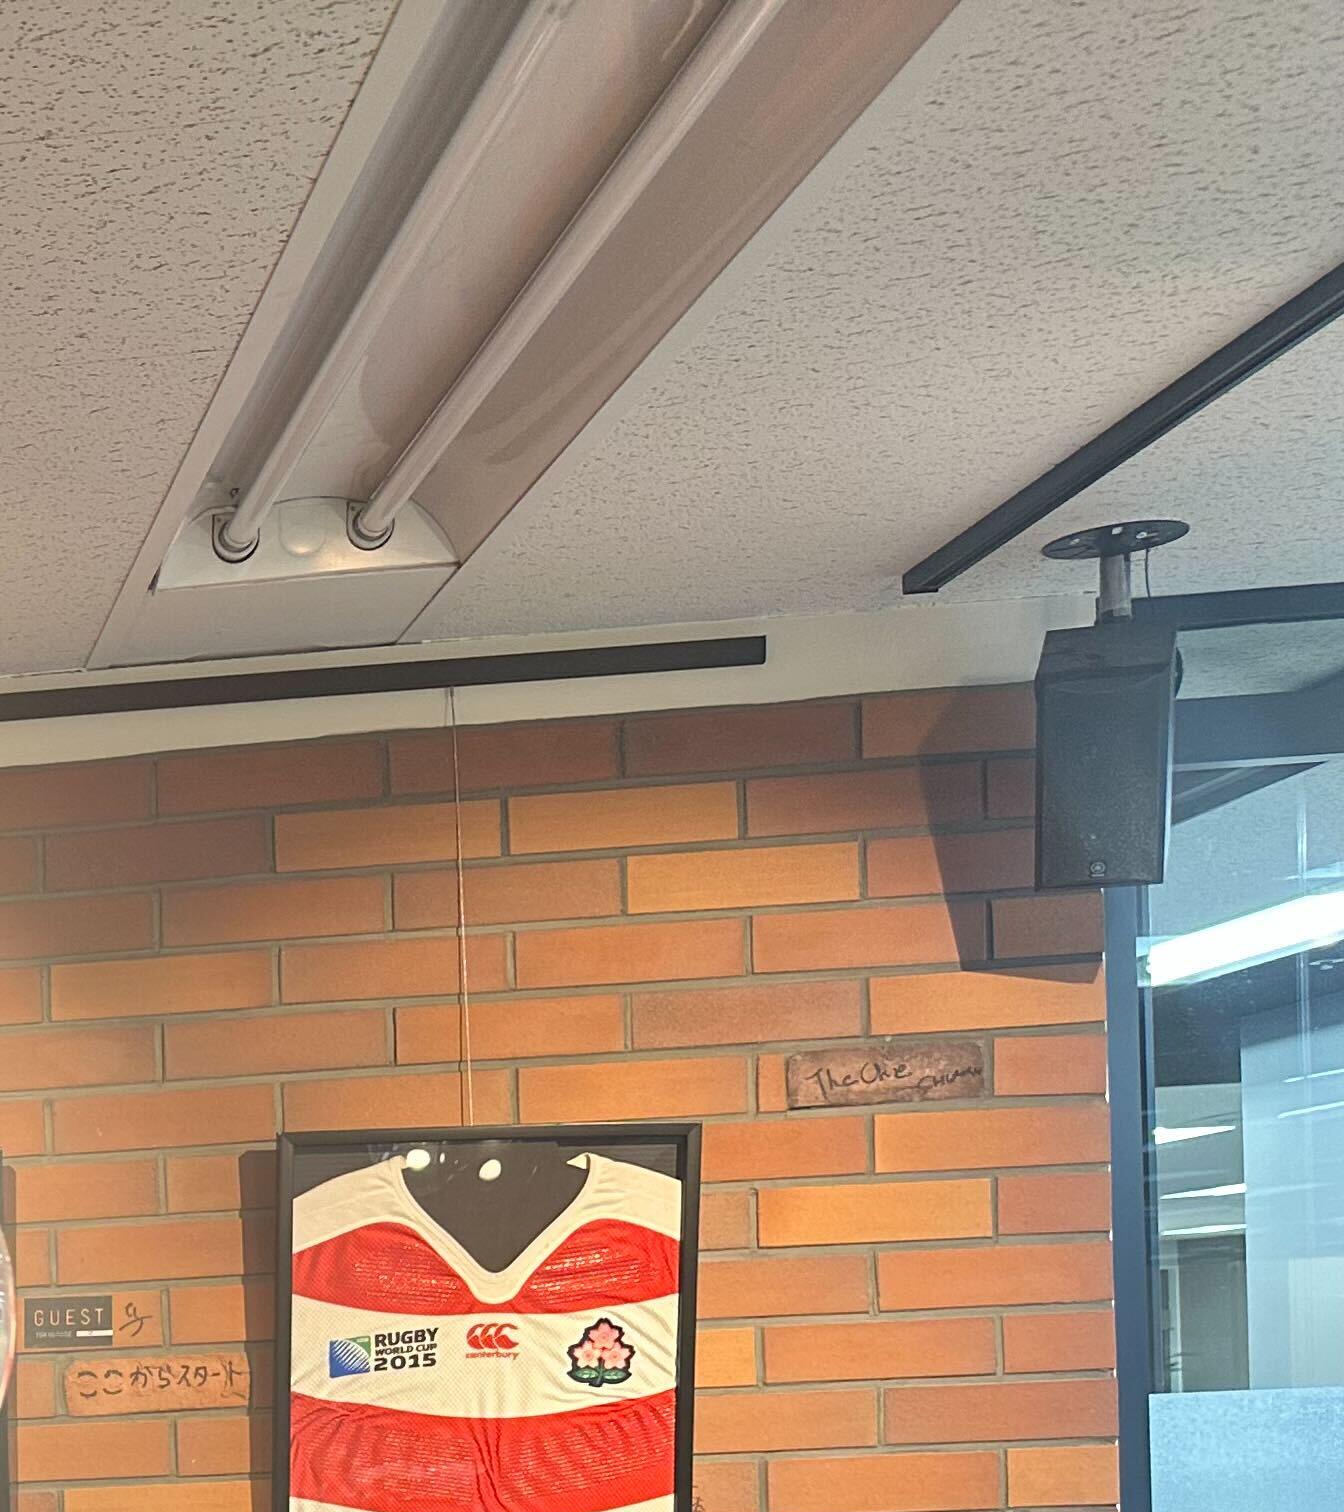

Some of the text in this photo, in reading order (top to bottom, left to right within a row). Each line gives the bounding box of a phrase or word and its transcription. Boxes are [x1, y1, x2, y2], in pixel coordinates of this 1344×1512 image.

[805, 1067, 859, 1100] The
[33, 1308, 105, 1327] GUEST
[374, 1327, 440, 1348] RUGBY
[374, 1343, 438, 1357] WORLD CUP
[465, 1351, 520, 1360] canterbury
[373, 1353, 437, 1372] 2015
